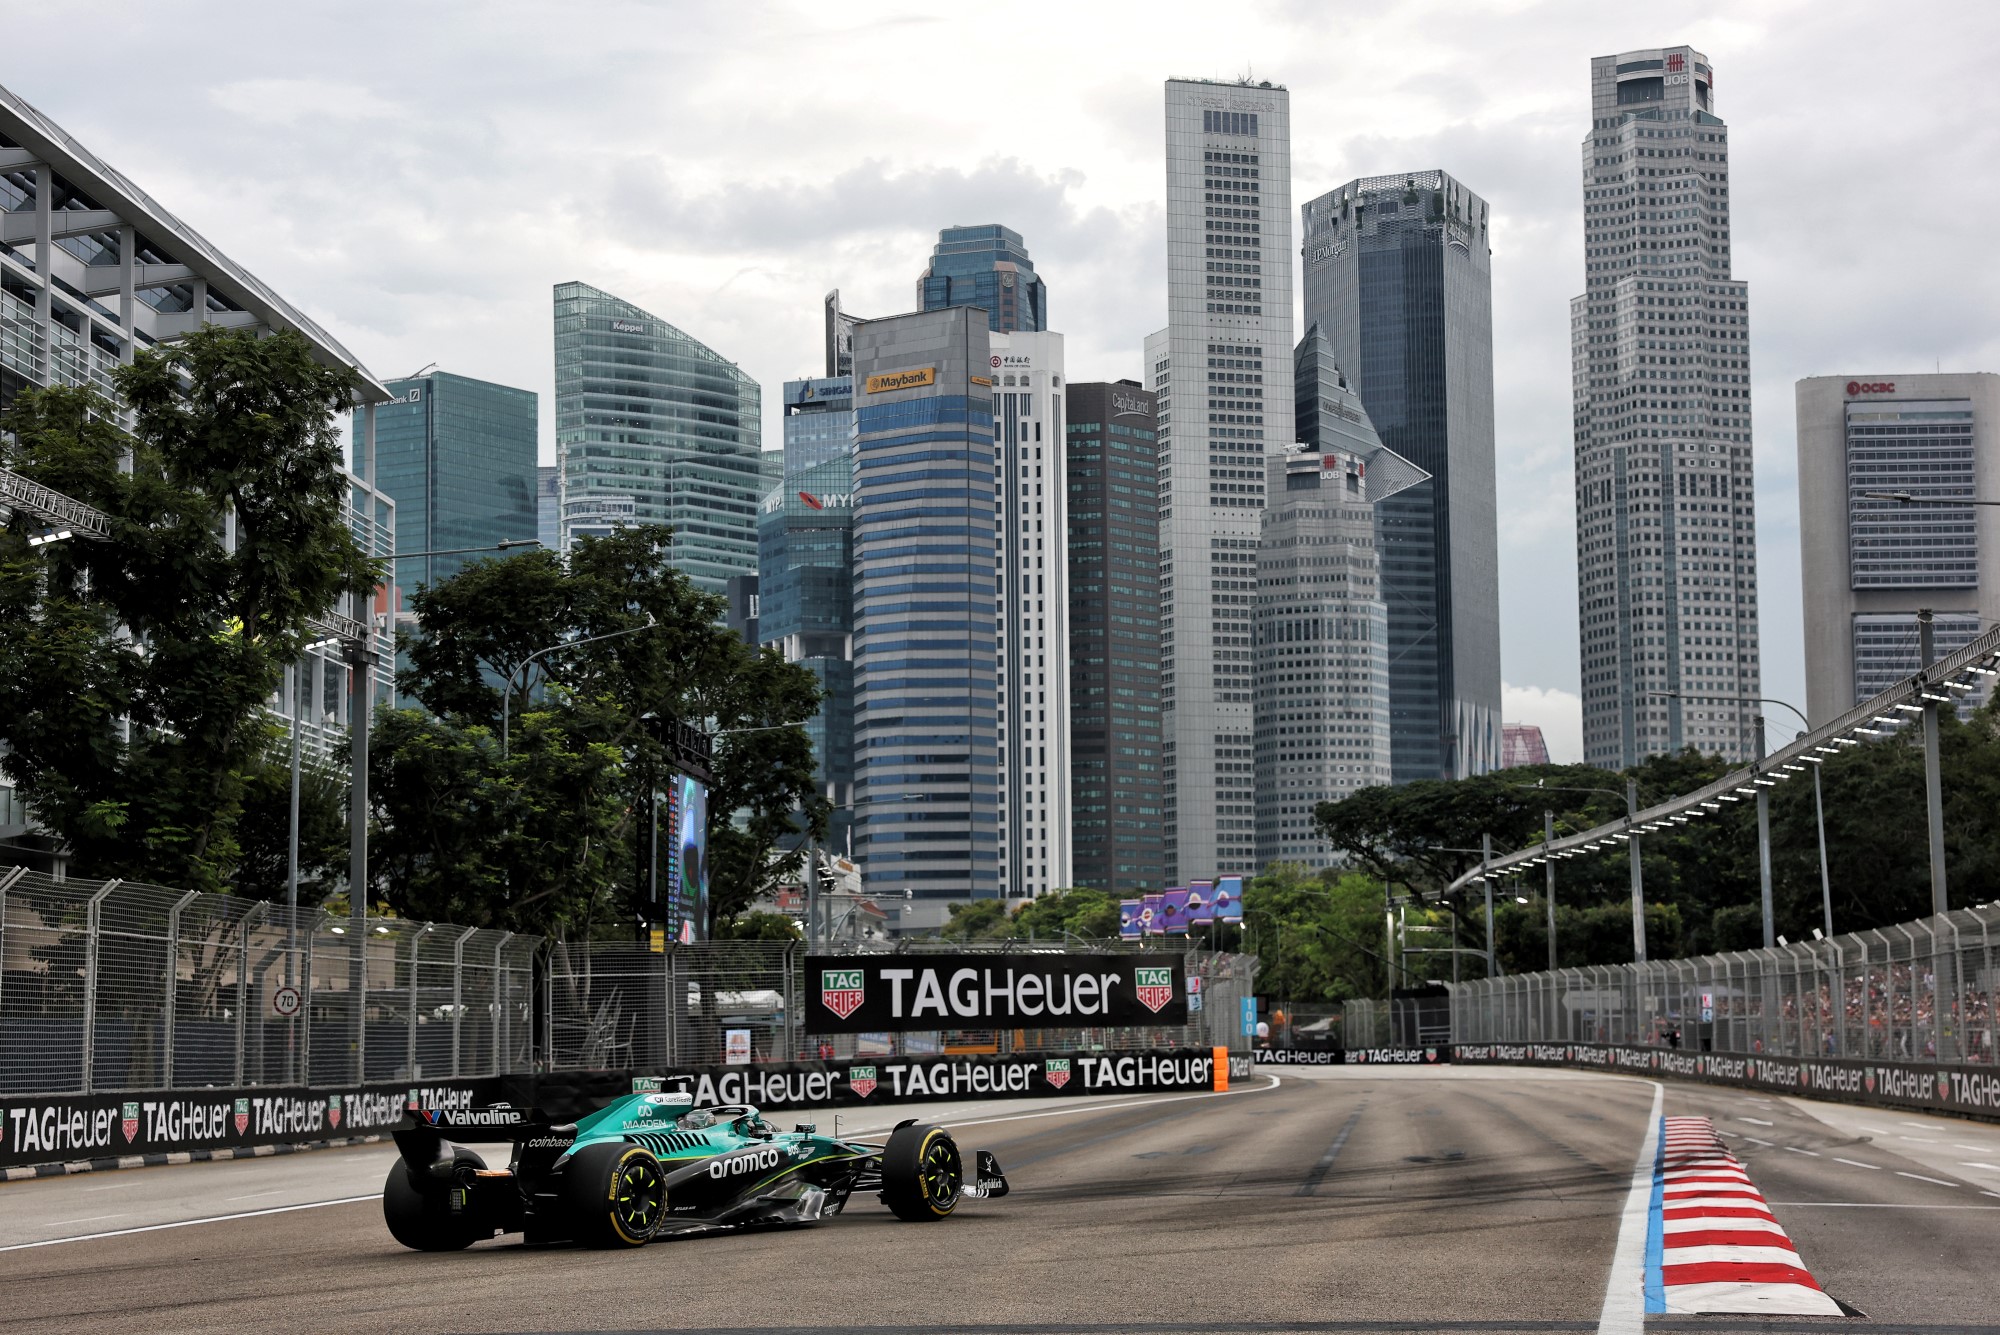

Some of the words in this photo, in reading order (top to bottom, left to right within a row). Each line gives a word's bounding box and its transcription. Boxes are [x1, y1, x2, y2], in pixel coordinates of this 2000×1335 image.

[1664, 75, 1689, 86] UOB
[613, 321, 644, 332] Keppel
[881, 372, 927, 388] Maybank
[1861, 383, 1895, 393] OCBC
[1112, 393, 1149, 413] CapitaLand
[1320, 471, 1340, 480] UOB
[826, 973, 860, 988] TAG
[1138, 970, 1169, 985] TAG
[281, 995, 294, 1007] 70
[825, 991, 862, 1016] HEUER
[1138, 987, 1170, 1009] HEUER
[1048, 1060, 1069, 1071] TAG
[852, 1068, 875, 1079] TAG
[1047, 1072, 1070, 1088] HEUER
[635, 1079, 660, 1089] TAG
[851, 1080, 876, 1095] HEUER
[124, 1103, 139, 1119] TAG
[444, 1110, 521, 1125] Valvoline
[622, 1119, 667, 1130] MAADEN
[529, 1136, 574, 1148] coinbase
[709, 1149, 779, 1179] aramco
